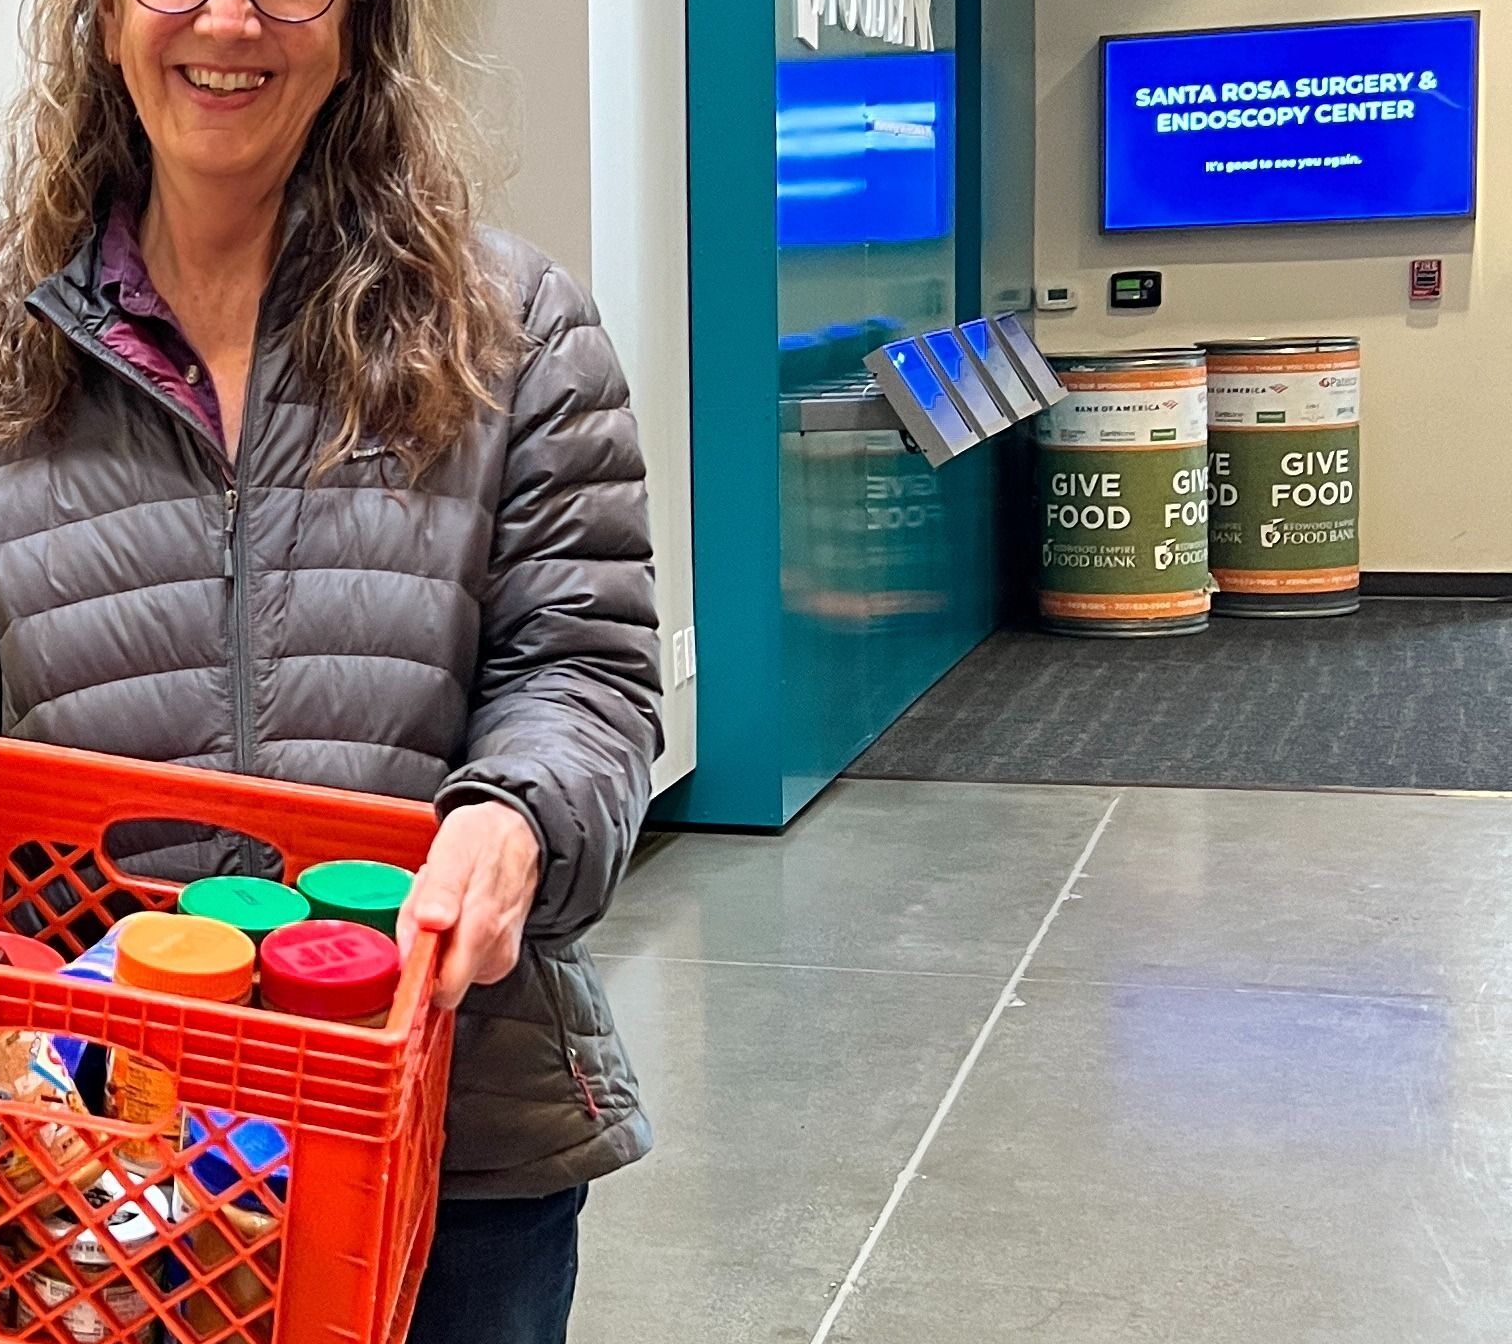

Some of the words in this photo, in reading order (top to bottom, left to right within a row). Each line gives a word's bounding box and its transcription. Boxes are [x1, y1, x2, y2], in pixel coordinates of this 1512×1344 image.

[1135, 85, 1217, 107] SANTA
[1221, 80, 1289, 103] ROSA
[1295, 71, 1414, 99] SURGERY
[1418, 70, 1437, 90] &
[1157, 105, 1310, 133] ENDOSCOPY
[1314, 100, 1414, 124] CENTER
[1205, 160, 1224, 172] It's
[1226, 158, 1258, 173] good
[1259, 157, 1273, 170] to
[1274, 158, 1296, 169] see
[1297, 157, 1322, 171] you
[1323, 154, 1362, 169] again.
[1281, 449, 1349, 476] GIVE
[1051, 473, 1121, 497] GIVE
[1172, 466, 1208, 495] GIV
[1271, 480, 1353, 507] FOOD
[1046, 504, 1131, 530] FOOD
[1164, 500, 1208, 528] FOO
[1283, 530, 1327, 545] FOOD
[1329, 528, 1355, 542] BANK
[1093, 555, 1136, 568] BANK
